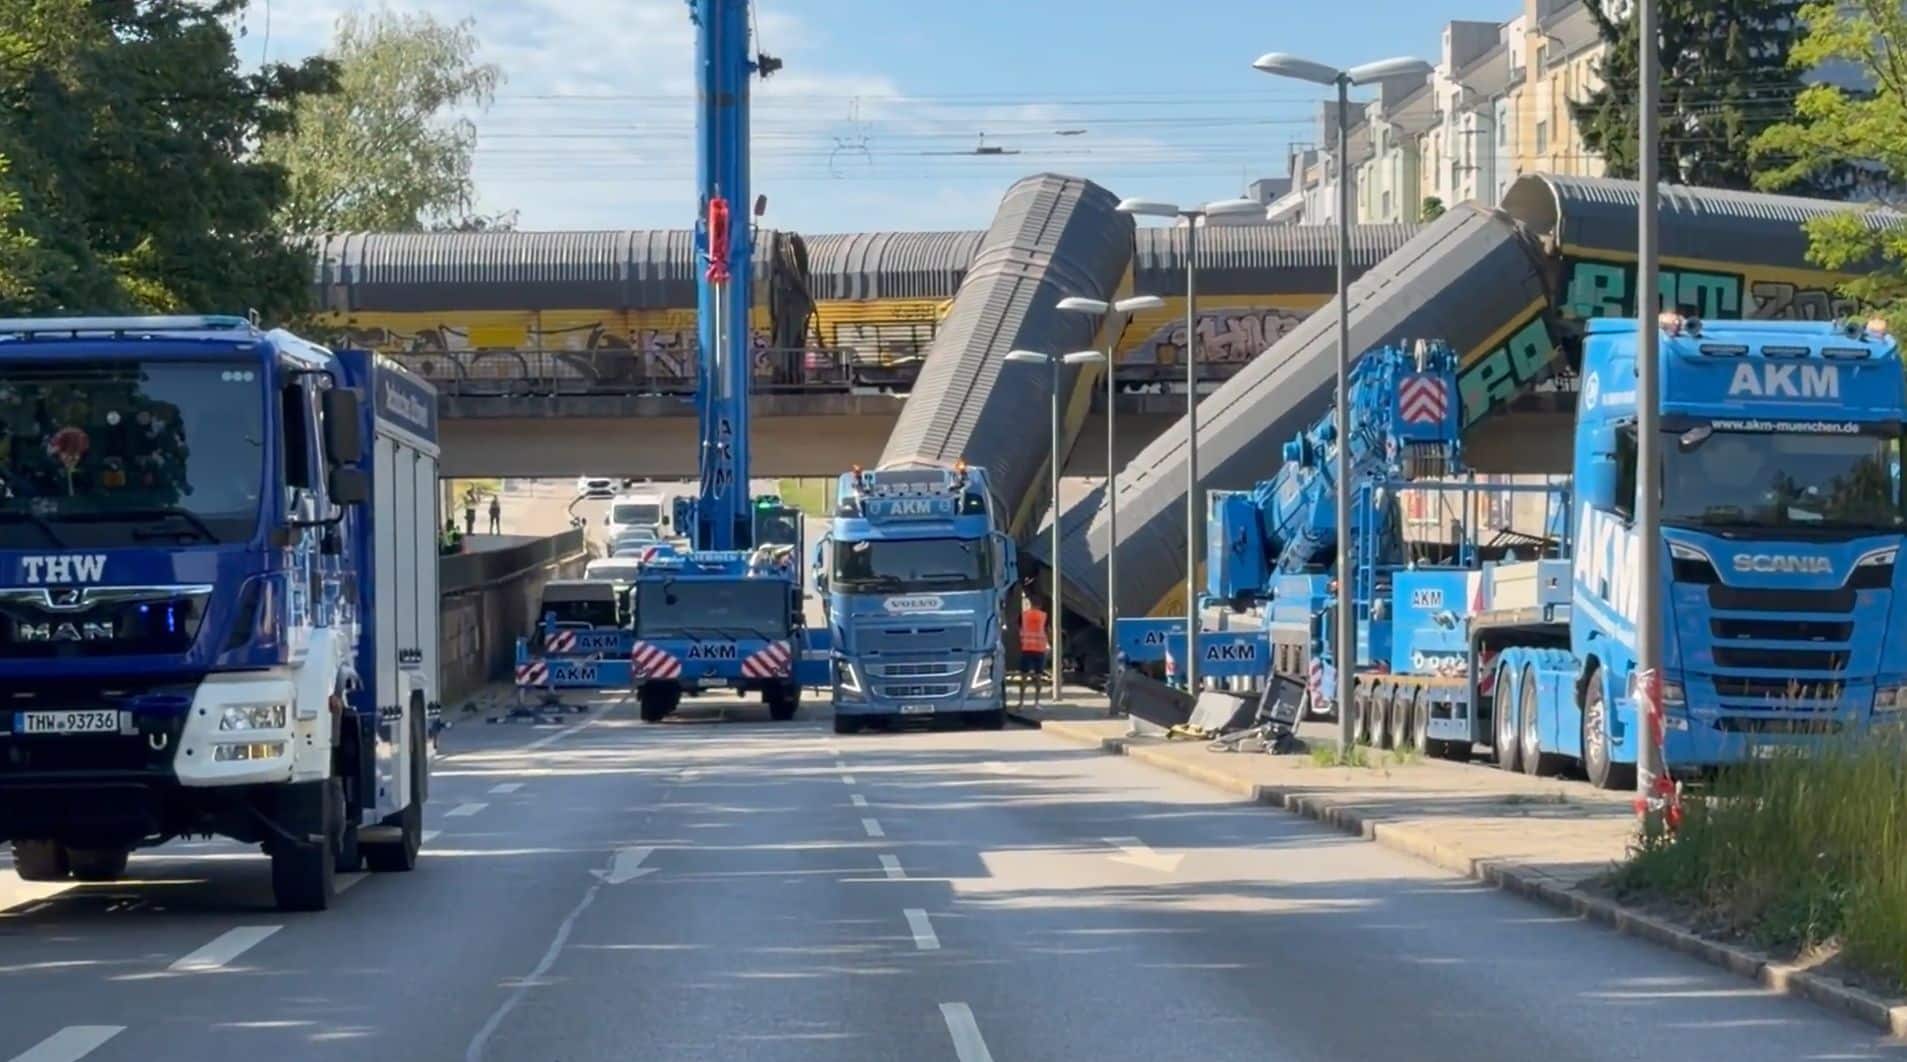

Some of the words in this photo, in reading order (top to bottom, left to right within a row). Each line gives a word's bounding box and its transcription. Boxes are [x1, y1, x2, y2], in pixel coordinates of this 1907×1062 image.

[1728, 363, 1839, 397] AKM
[1711, 418, 1859, 433] www.akm-muenchen.de
[890, 500, 931, 514] AKM
[22, 555, 107, 583] THW
[1573, 501, 1641, 625] AKM
[1733, 554, 1832, 573] SCANIA
[890, 599, 937, 608] VOLVO
[1413, 590, 1442, 606] AKM
[21, 622, 114, 640] MAN
[581, 636, 618, 648] AKM
[688, 644, 737, 659] AKM
[1207, 645, 1256, 660] AKM
[555, 667, 597, 681] AKM
[27, 714, 55, 730] THW
[67, 712, 114, 729] 93736
